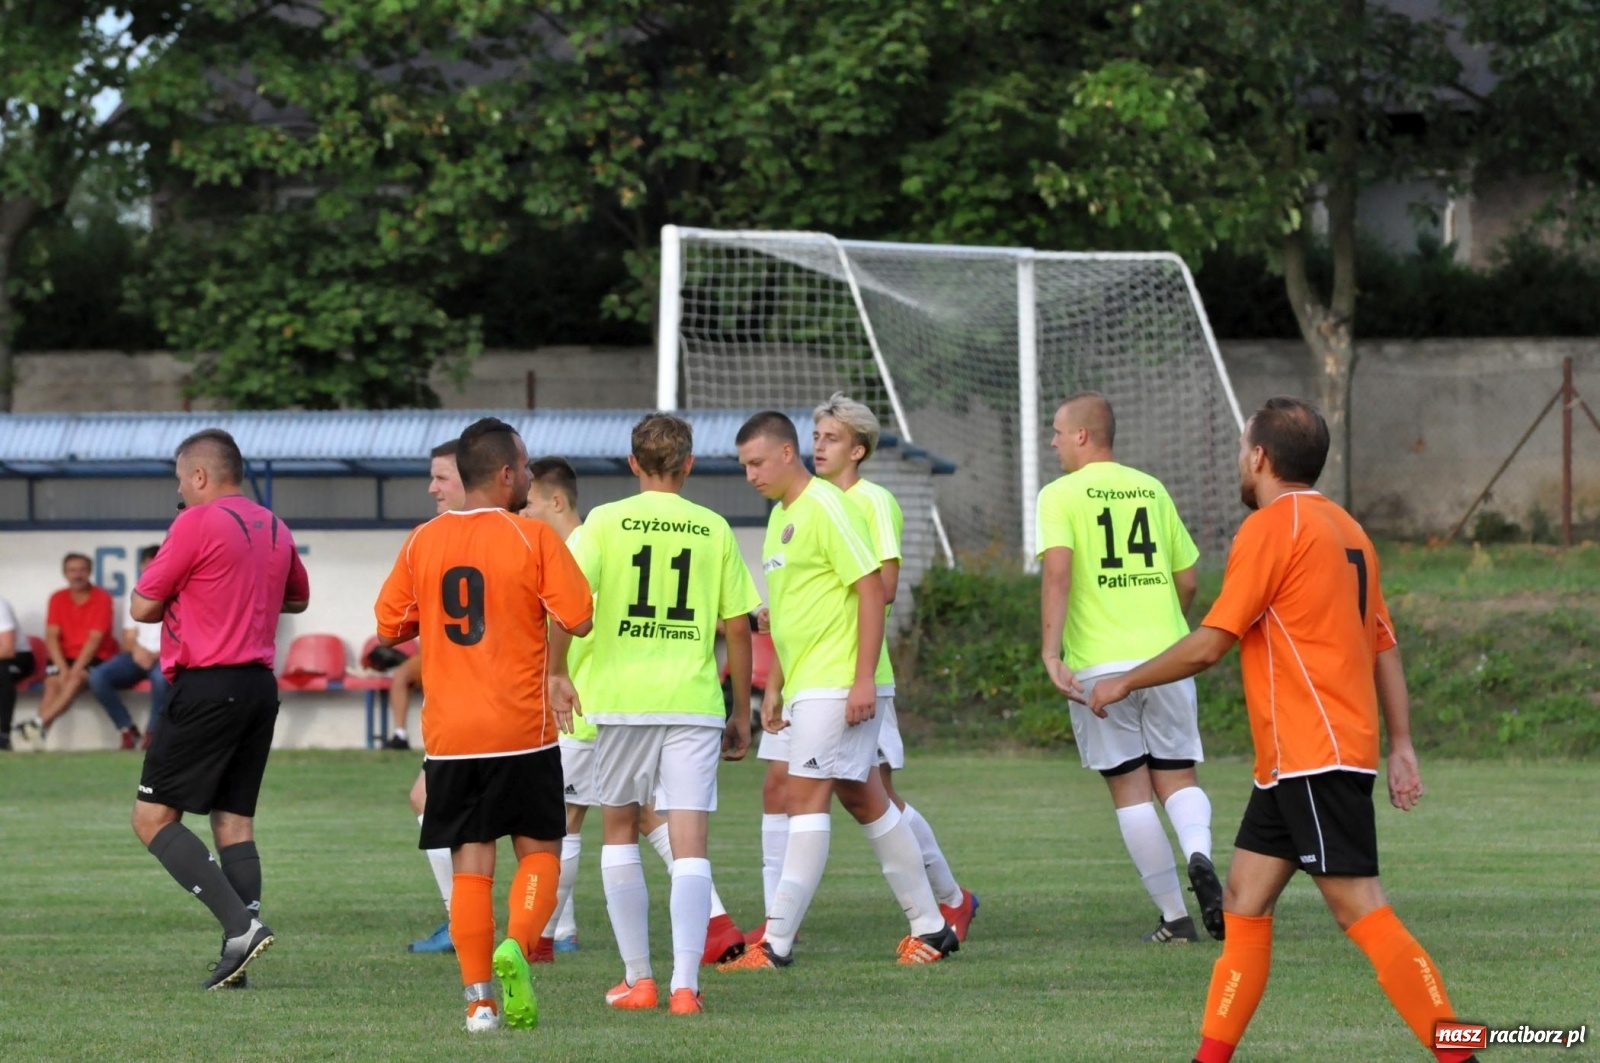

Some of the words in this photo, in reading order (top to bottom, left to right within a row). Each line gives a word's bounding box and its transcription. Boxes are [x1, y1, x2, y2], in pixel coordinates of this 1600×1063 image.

[1086, 487, 1156, 501] Czyżowice
[621, 518, 710, 536] Czyżowice
[1097, 507, 1157, 569] 14
[628, 544, 695, 622] 11
[1097, 573, 1127, 588] Pati
[1131, 575, 1161, 587] Trans
[442, 566, 485, 646] 9
[618, 620, 656, 639] Pati
[659, 626, 695, 640] Trans
